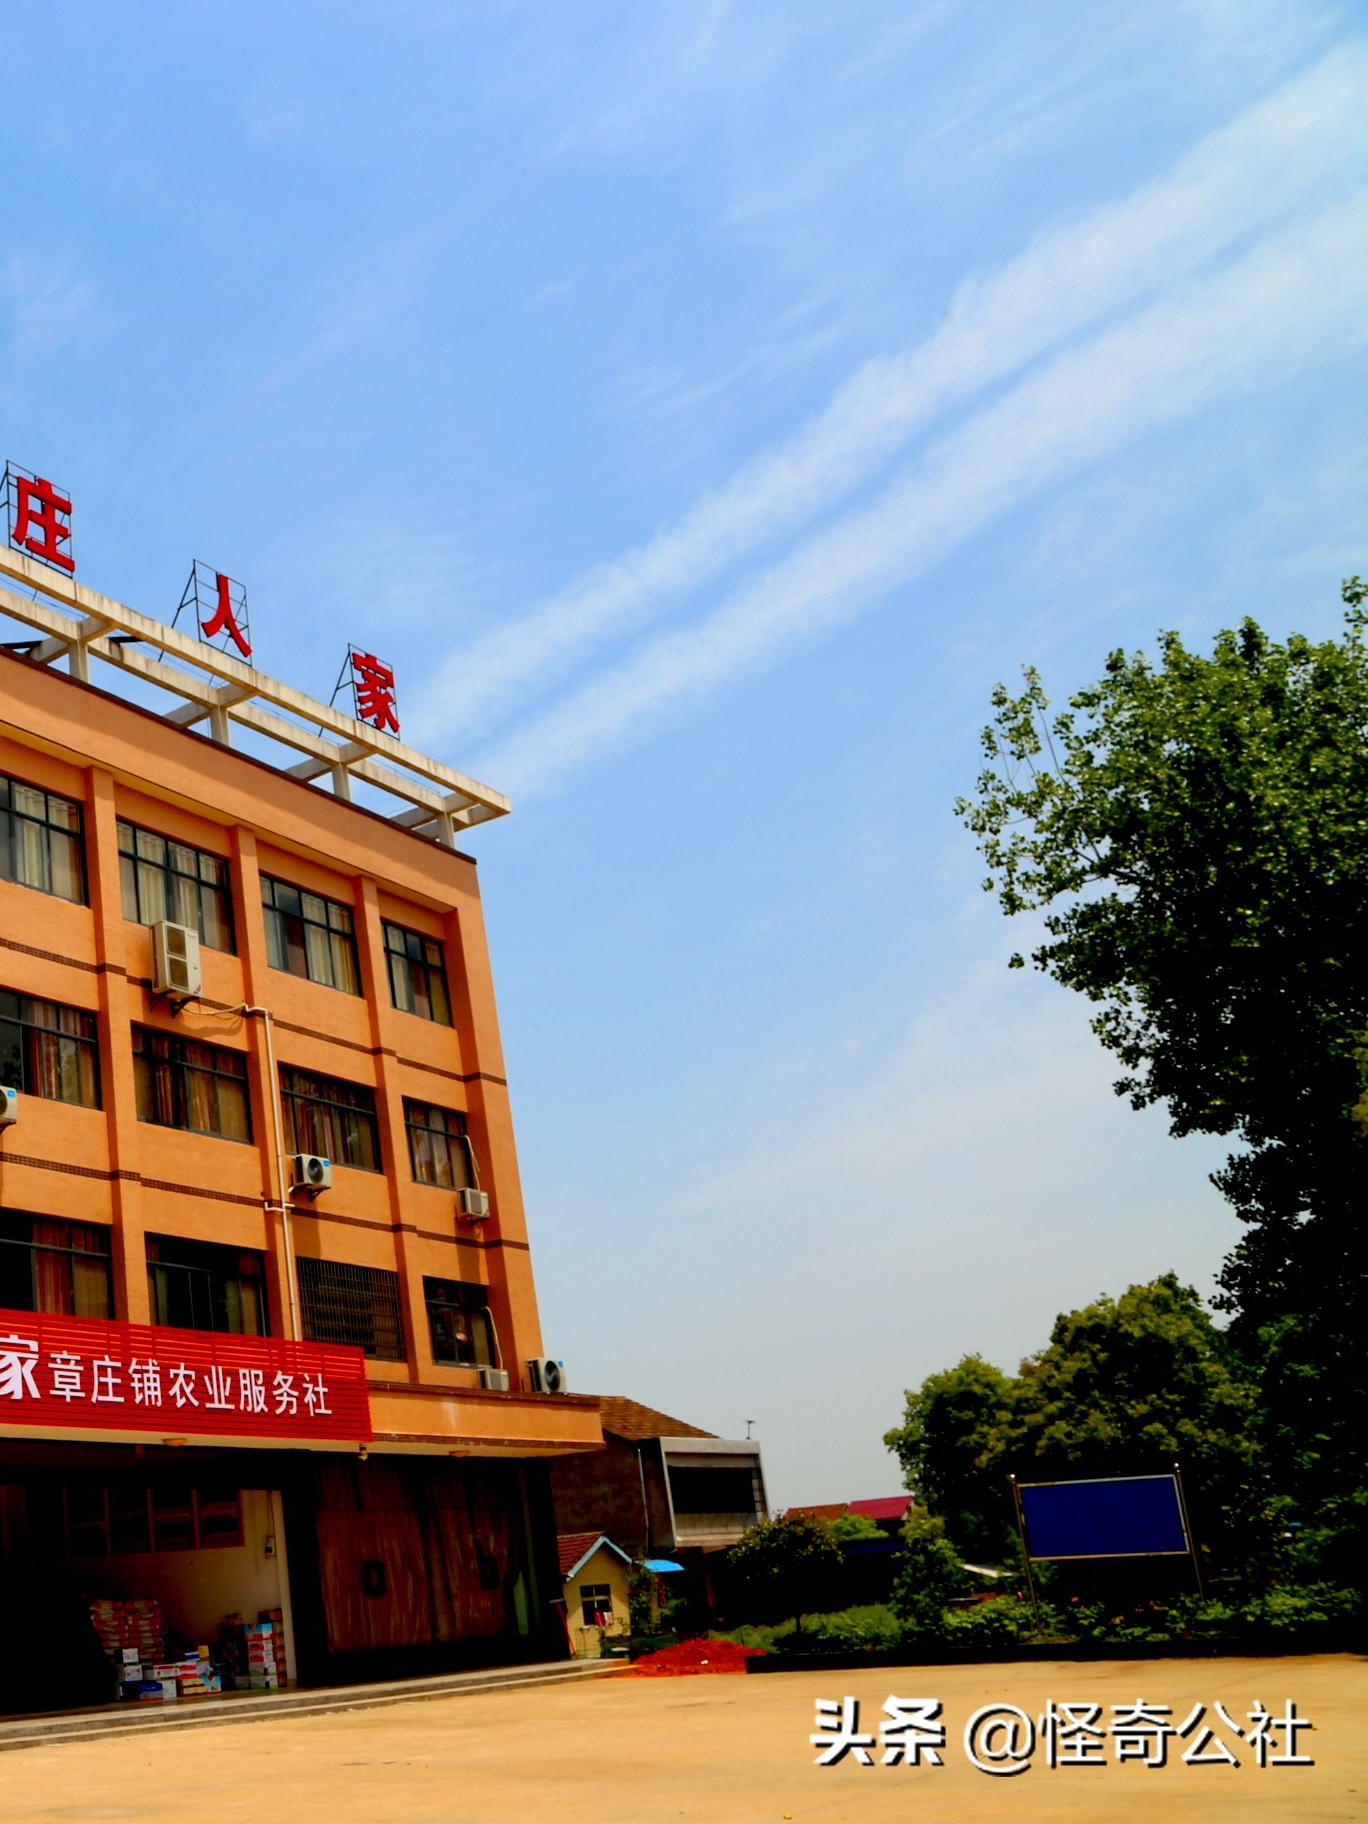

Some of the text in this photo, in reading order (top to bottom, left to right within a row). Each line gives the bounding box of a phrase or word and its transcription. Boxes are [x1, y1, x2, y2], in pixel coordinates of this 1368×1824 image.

[48, 1351, 332, 1416] 章庄铺农业服务社
